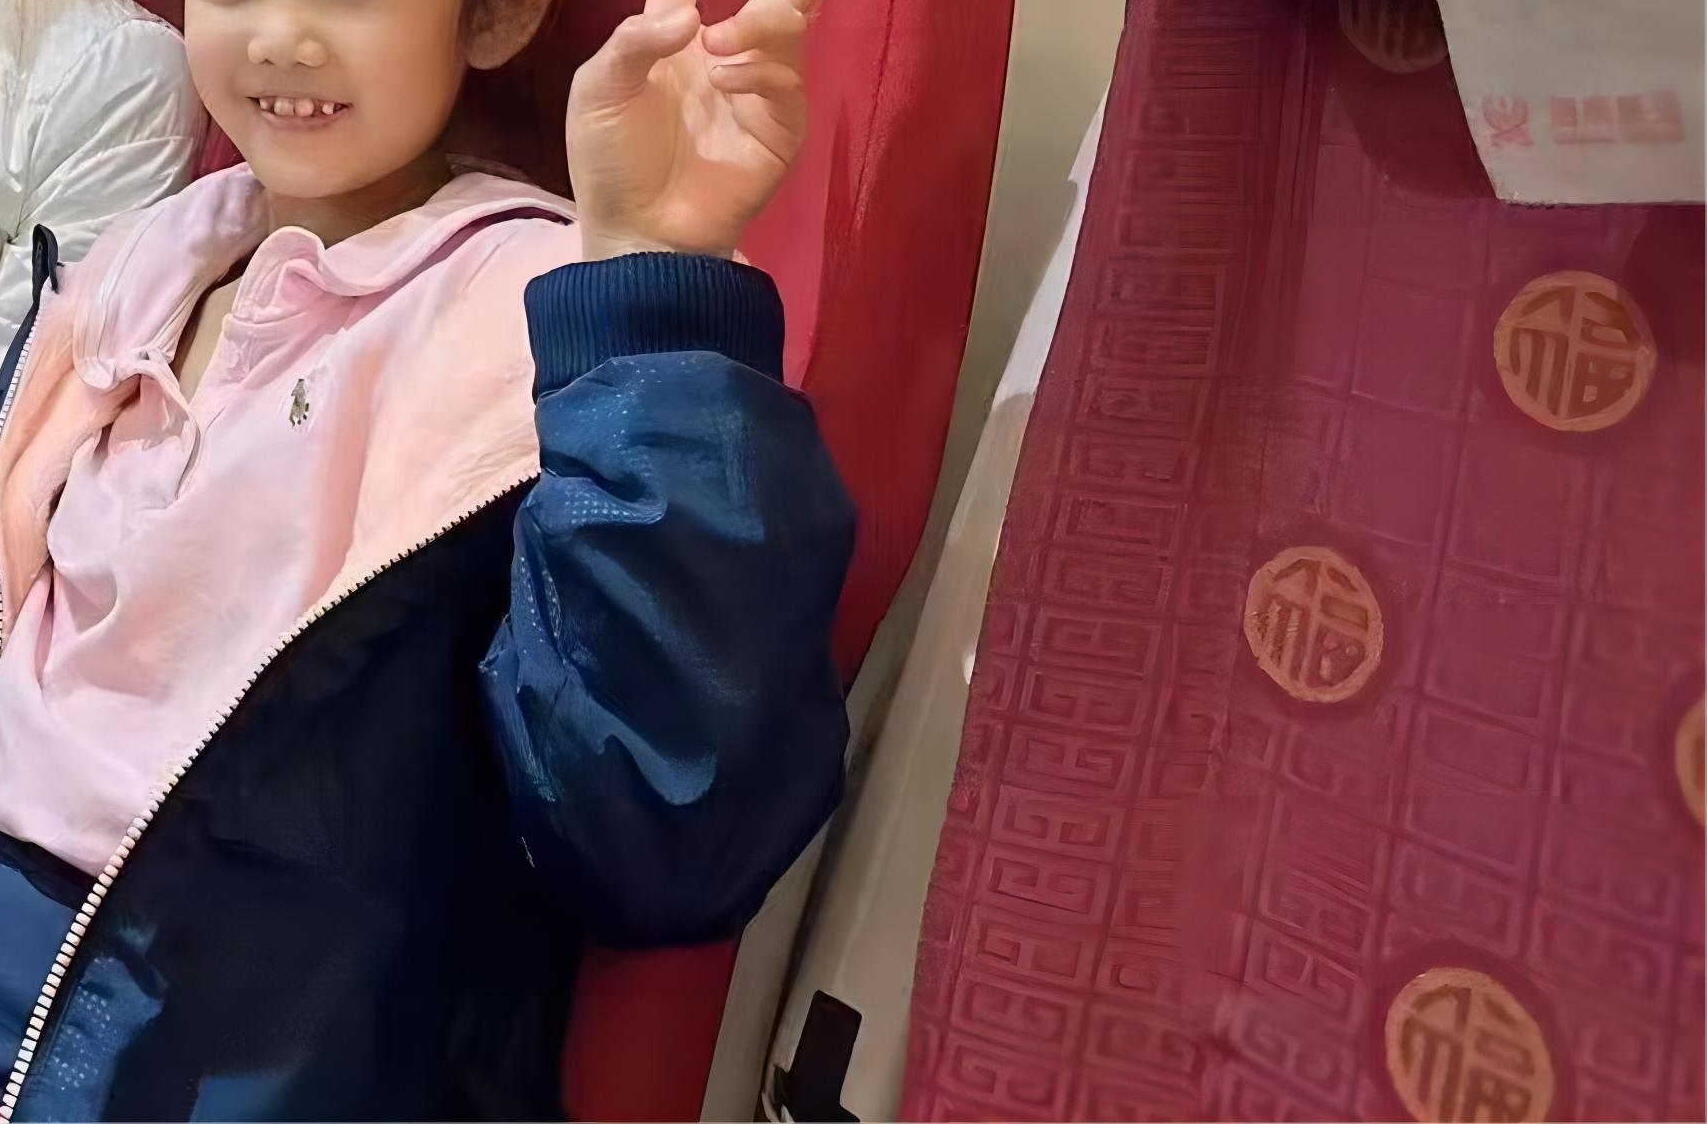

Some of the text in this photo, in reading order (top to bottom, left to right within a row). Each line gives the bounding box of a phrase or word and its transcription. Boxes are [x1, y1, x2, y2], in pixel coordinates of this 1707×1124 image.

[1507, 283, 1645, 421] 福
[1256, 558, 1370, 689] 福
[1398, 983, 1537, 1123] 福
